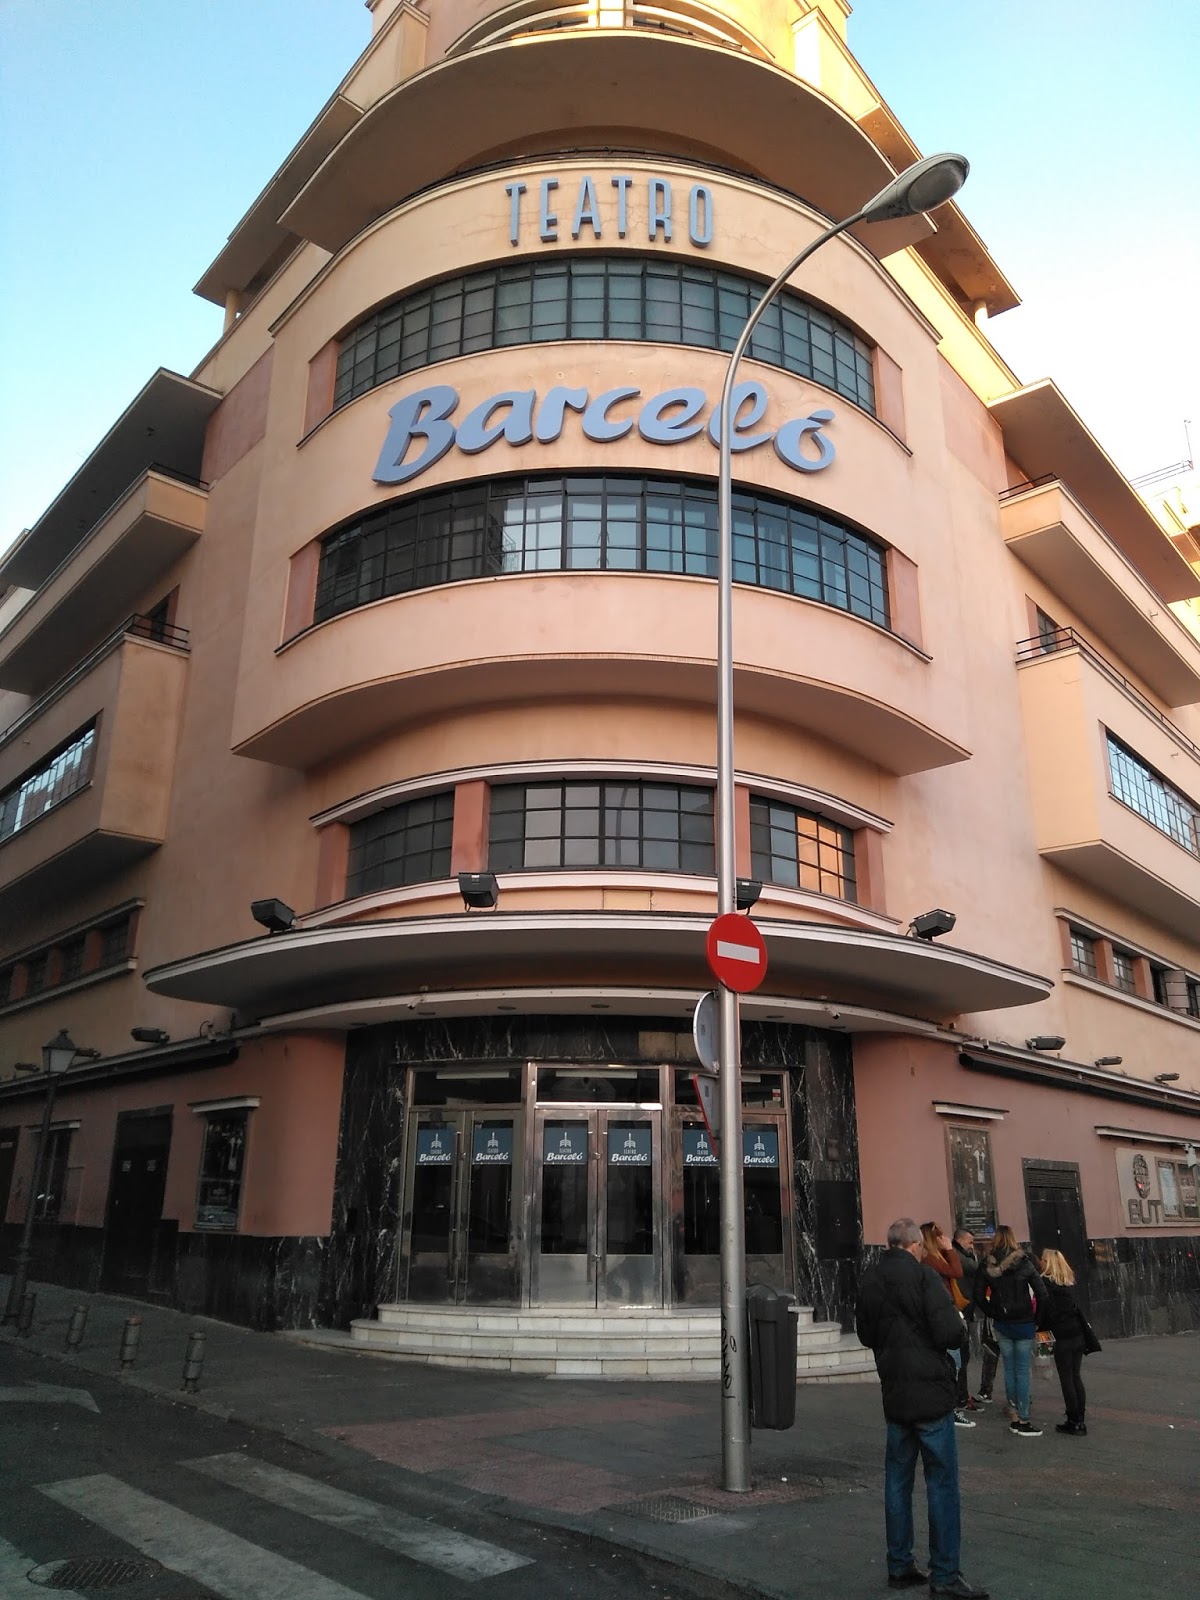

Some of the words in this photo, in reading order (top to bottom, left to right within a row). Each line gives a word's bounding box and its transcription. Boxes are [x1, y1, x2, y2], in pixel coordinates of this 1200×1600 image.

[505, 176, 713, 248] TEATRO
[371, 381, 836, 486] Barceló
[1128, 1198, 1162, 1225] BUT
